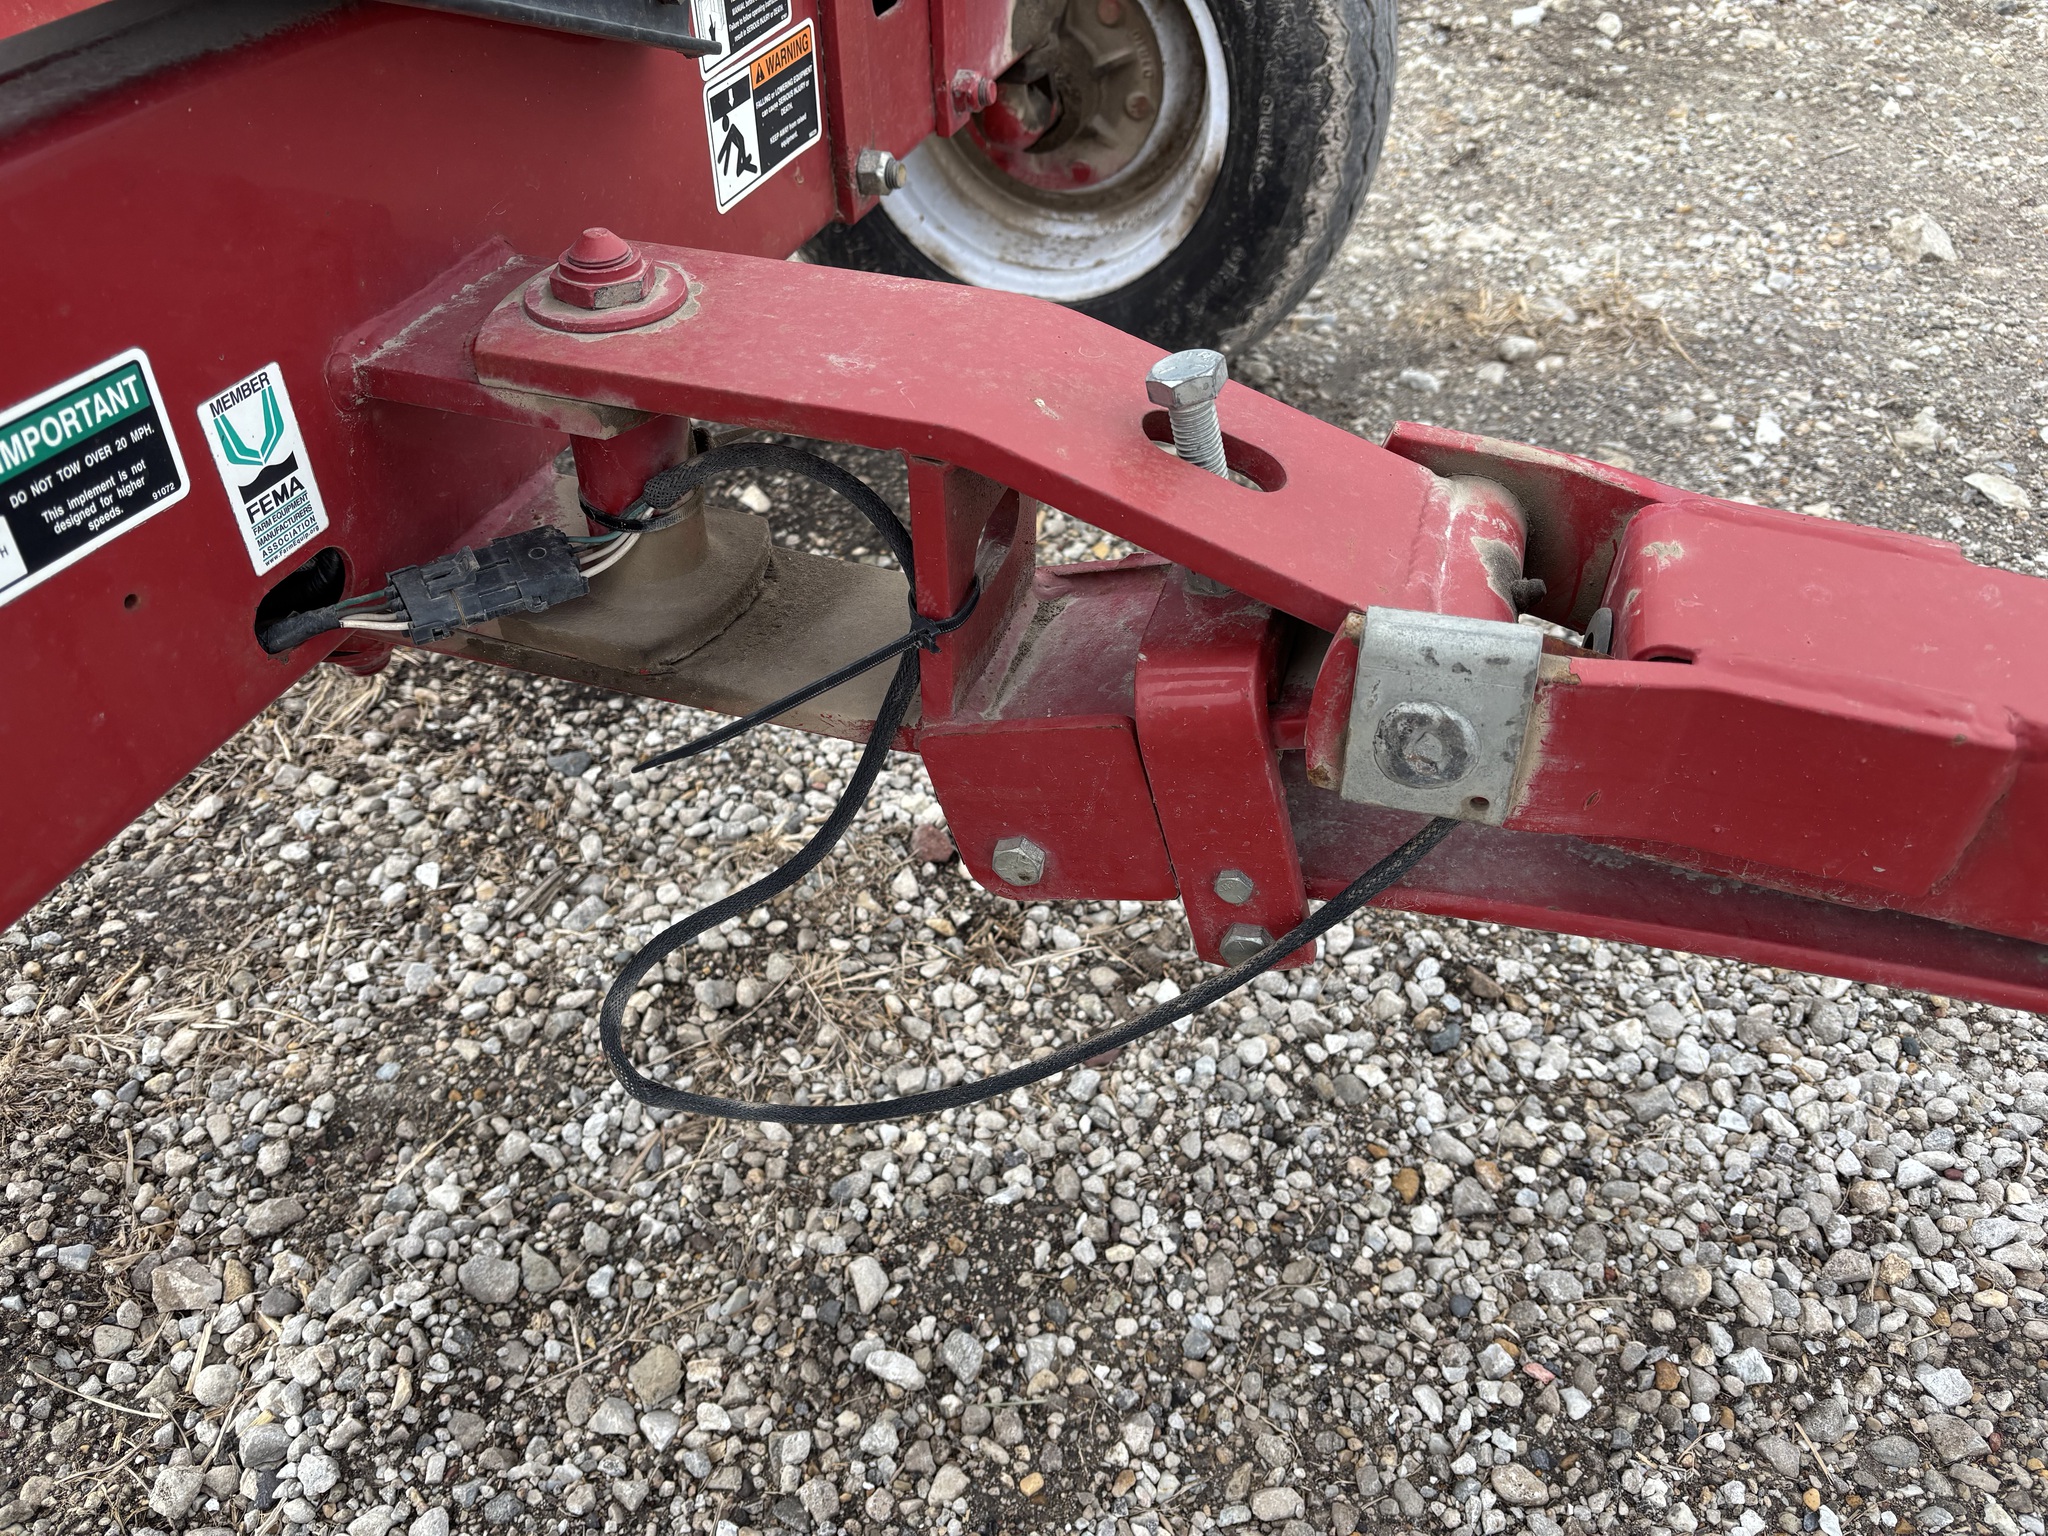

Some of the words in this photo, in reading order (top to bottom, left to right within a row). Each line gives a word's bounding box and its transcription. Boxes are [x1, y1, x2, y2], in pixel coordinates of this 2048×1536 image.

[746, 20, 760, 34] SERIOUS
[760, 13, 770, 25] INJURY
[765, 33, 809, 76] WARNING
[756, 94, 771, 109] FALLING
[775, 78, 794, 96] LOWERING
[793, 65, 812, 83] EQUIPMENT
[768, 102, 779, 113] cause
[778, 90, 794, 106] SERIOUS
[793, 81, 806, 95] INJURY
[769, 132, 779, 145] KEEP
[779, 125, 789, 137] AWAY
[789, 121, 797, 130] from
[797, 112, 807, 125] raised
[209, 371, 270, 418] MEMBER
[0, 374, 139, 474] MPORTANT
[9, 490, 28, 508] DO
[30, 476, 53, 498] NOT
[56, 460, 81, 482] TOW
[84, 444, 112, 467] OVER
[114, 436, 128, 452] 20
[130, 423, 155, 444] MPH.
[41, 505, 64, 524] This
[67, 475, 116, 509] implement
[118, 470, 128, 482] is
[131, 459, 147, 476] not
[53, 499, 97, 535] designed
[100, 494, 114, 508] for
[116, 476, 145, 499] higher
[152, 483, 175, 500] 91072
[246, 476, 305, 524] FEMA
[88, 505, 124, 532] speeds.
[253, 519, 272, 536] FARM
[272, 493, 309, 523] EQUIPMENT
[256, 504, 313, 547] MANUFACTURERS
[262, 515, 316, 558] ASSOCIATION
[265, 525, 320, 566] www.FarmEquip.org
